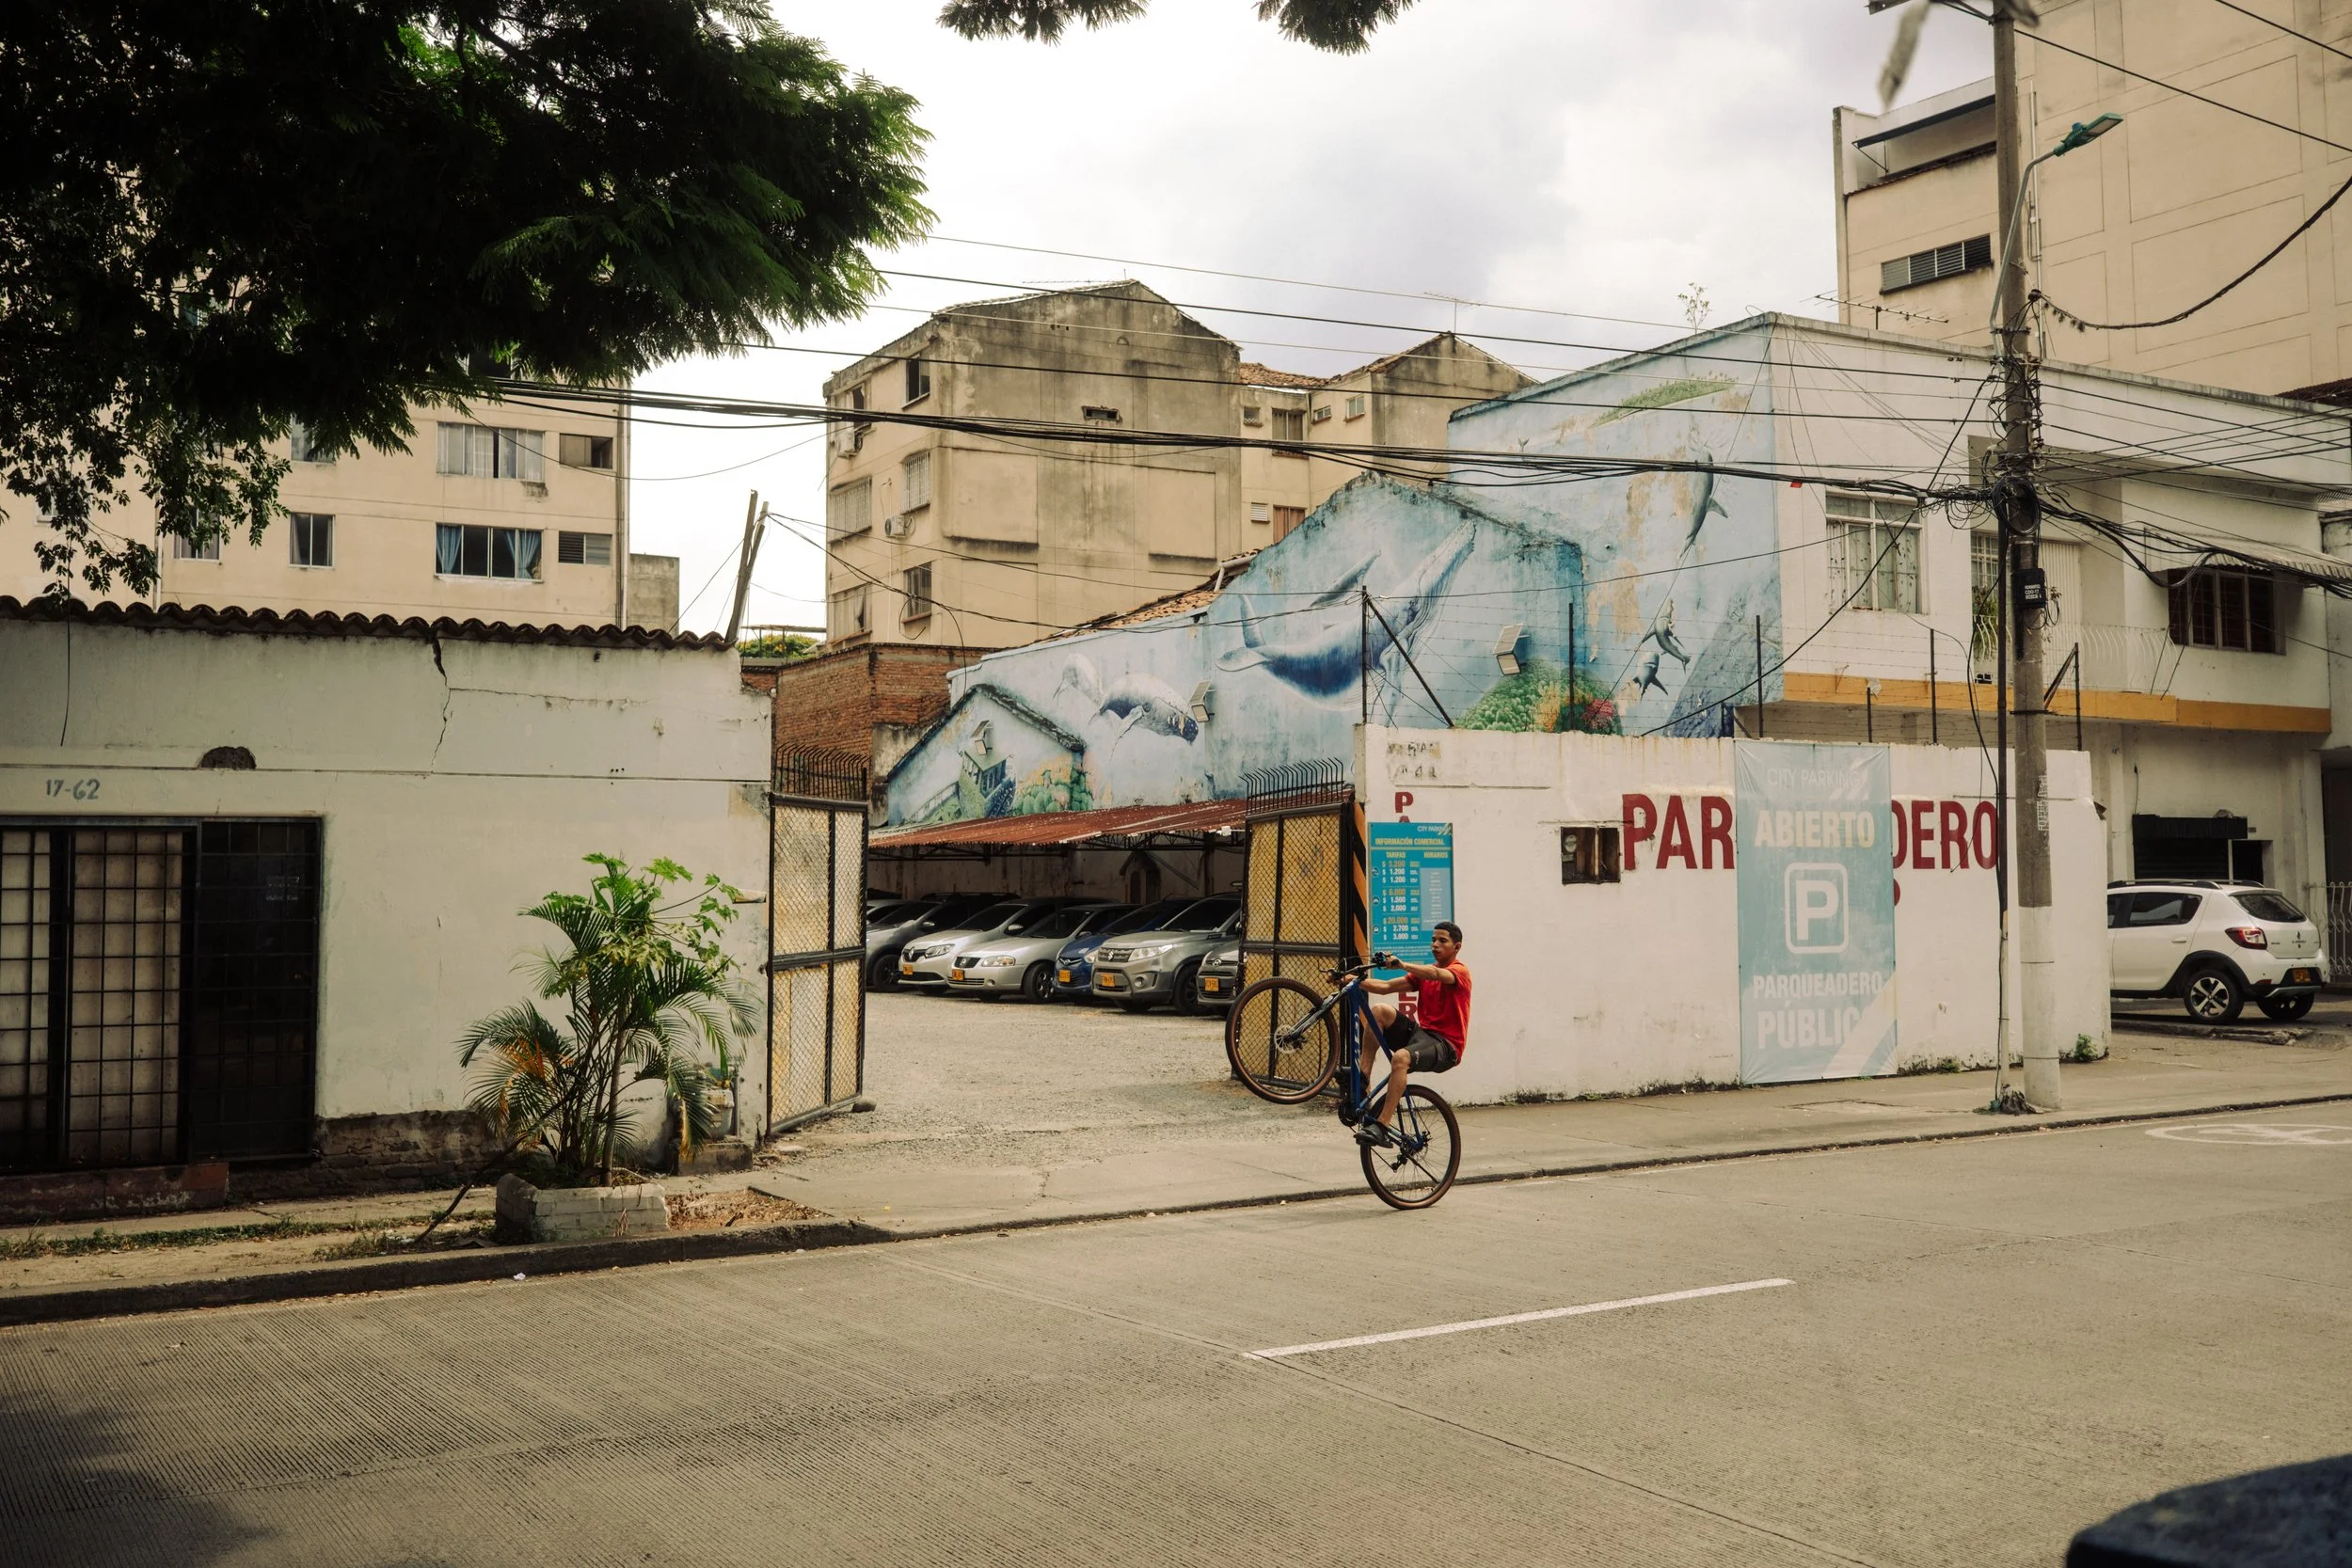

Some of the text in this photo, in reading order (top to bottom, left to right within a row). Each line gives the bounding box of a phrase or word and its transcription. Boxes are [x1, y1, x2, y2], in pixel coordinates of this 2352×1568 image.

[46, 779, 101, 800] 17-62
[1767, 768, 1862, 789] CITY PARKING
[1375, 836, 1413, 846] INFORMACIÓN
[1755, 810, 1875, 849] ABIERTO
[1795, 879, 1838, 941] P
[1753, 971, 1883, 999] PARQUEADERO
[1757, 1000, 1872, 1050] PÚBLIC
